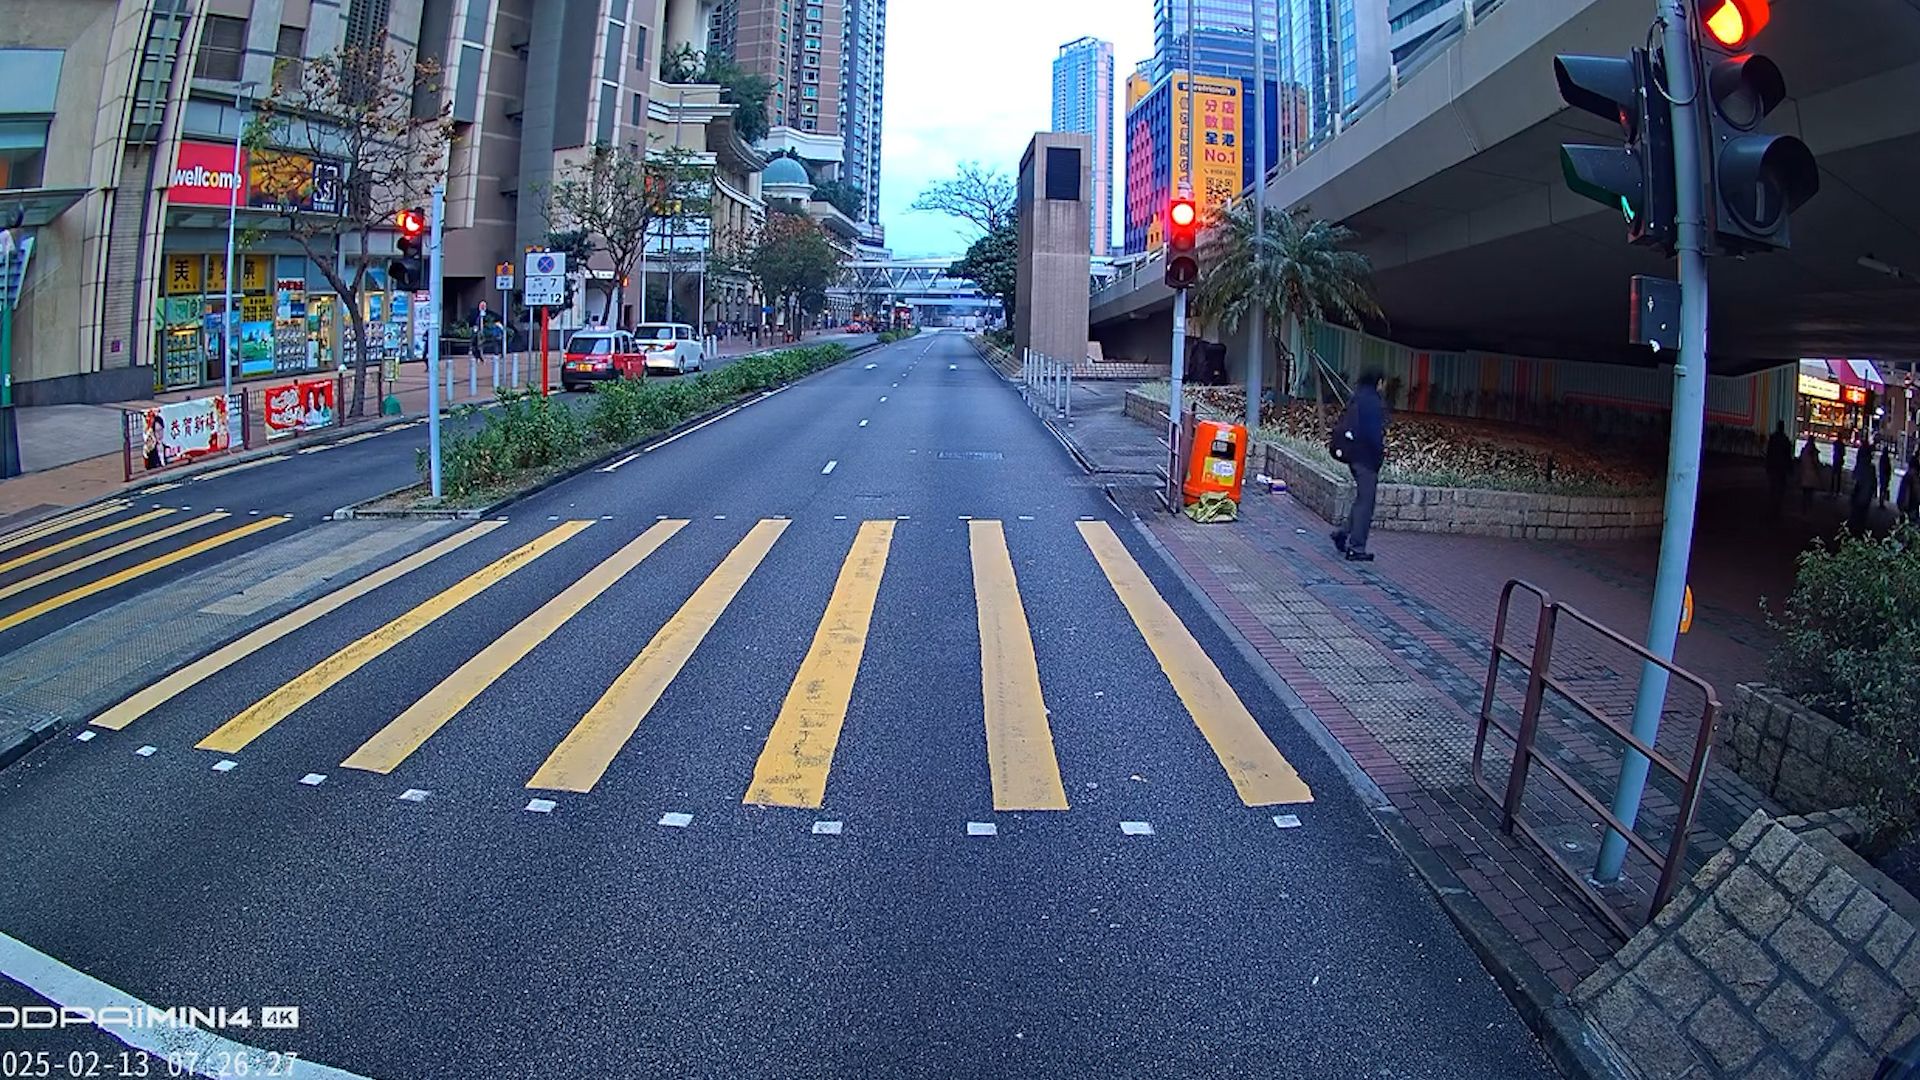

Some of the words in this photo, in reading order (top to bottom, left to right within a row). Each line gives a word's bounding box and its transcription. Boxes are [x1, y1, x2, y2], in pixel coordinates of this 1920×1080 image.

[1205, 99, 1236, 114] 分店
[1205, 131, 1235, 147] 全港
[1205, 148, 1236, 164] No.1
[173, 166, 243, 189] wellcome
[550, 278, 557, 287] 7
[551, 293, 562, 303] 12
